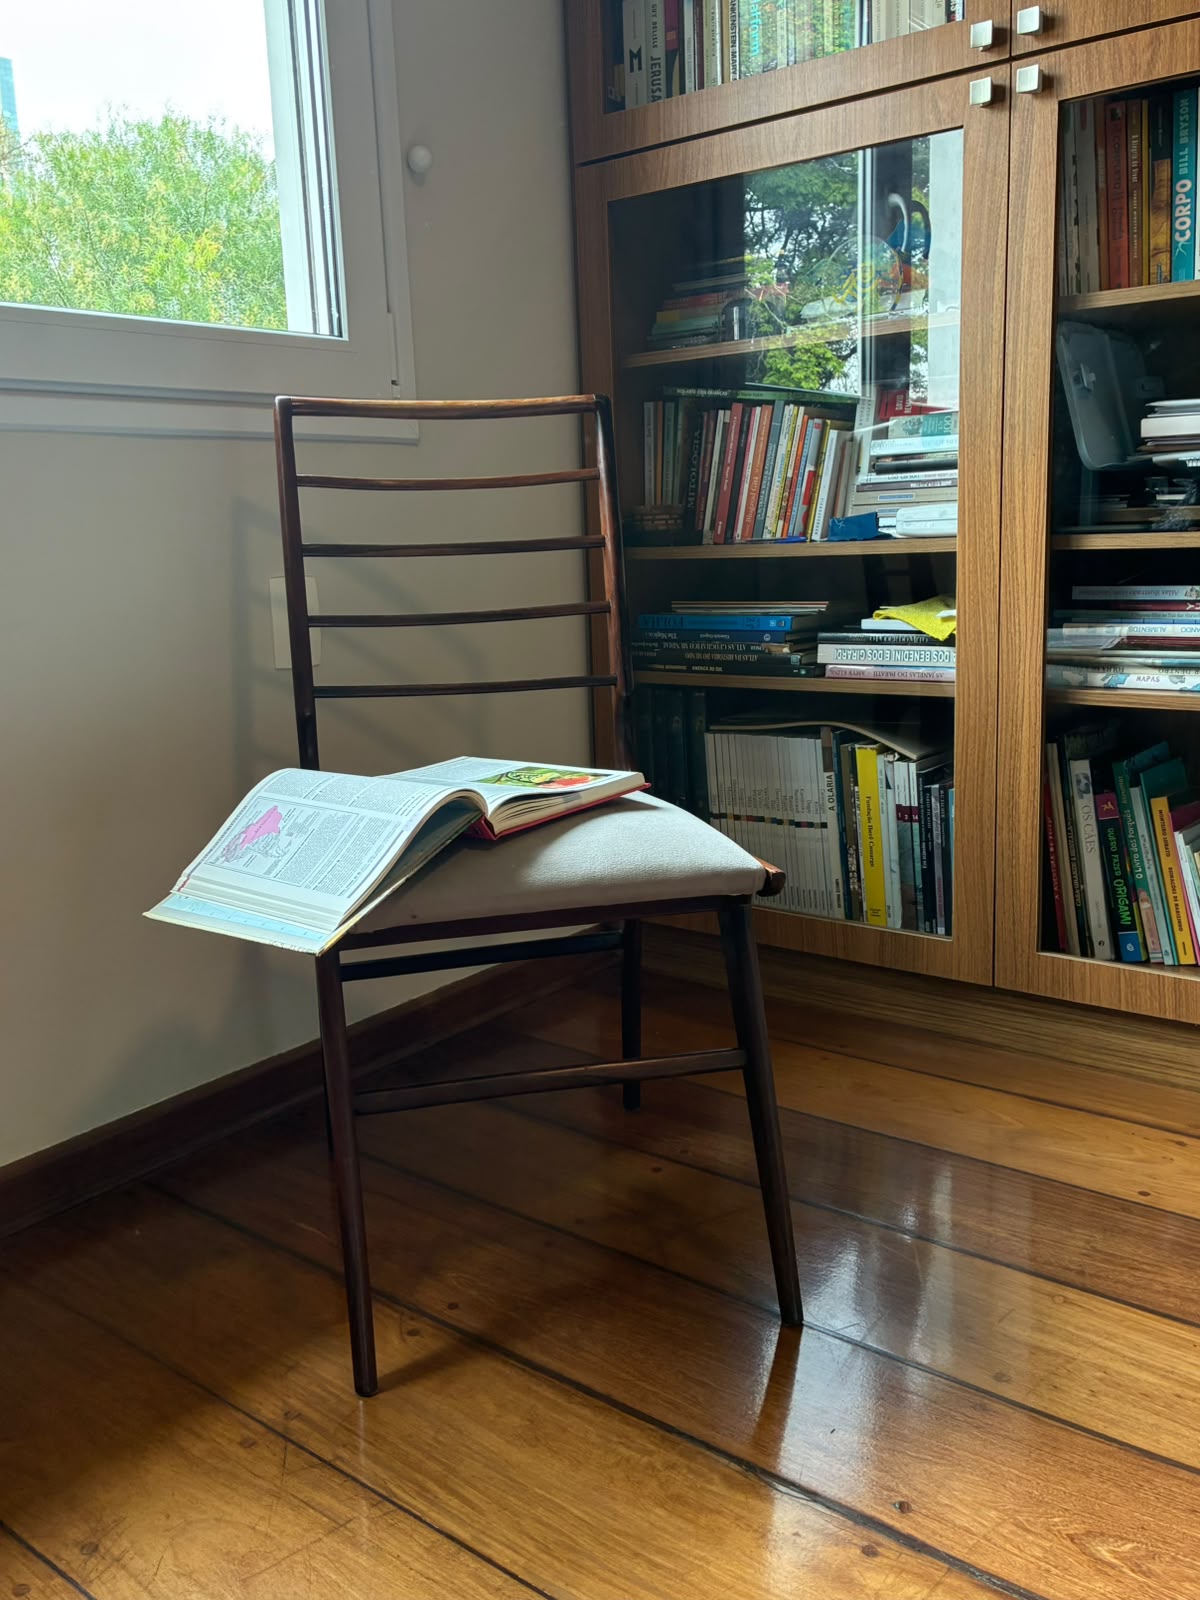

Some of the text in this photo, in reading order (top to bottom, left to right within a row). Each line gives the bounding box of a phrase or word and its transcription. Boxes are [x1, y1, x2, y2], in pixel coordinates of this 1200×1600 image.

[1178, 98, 1190, 175] BILL BRYSON
[1174, 179, 1192, 242] CORPO
[687, 430, 702, 508] MITOLOGIA
[834, 648, 950, 663] DOS BENEDINI E DOS GIRARDI
[909, 671, 936, 679] JANELAS
[826, 774, 834, 804] OLARIA
[1082, 804, 1097, 854] OS CÃES
[1124, 809, 1135, 838] Porquês
[1130, 839, 1138, 852] dos
[1158, 809, 1171, 857] MONTEIRO LOBATO
[1107, 827, 1132, 925] QUERO FAZER ORIGAMI
